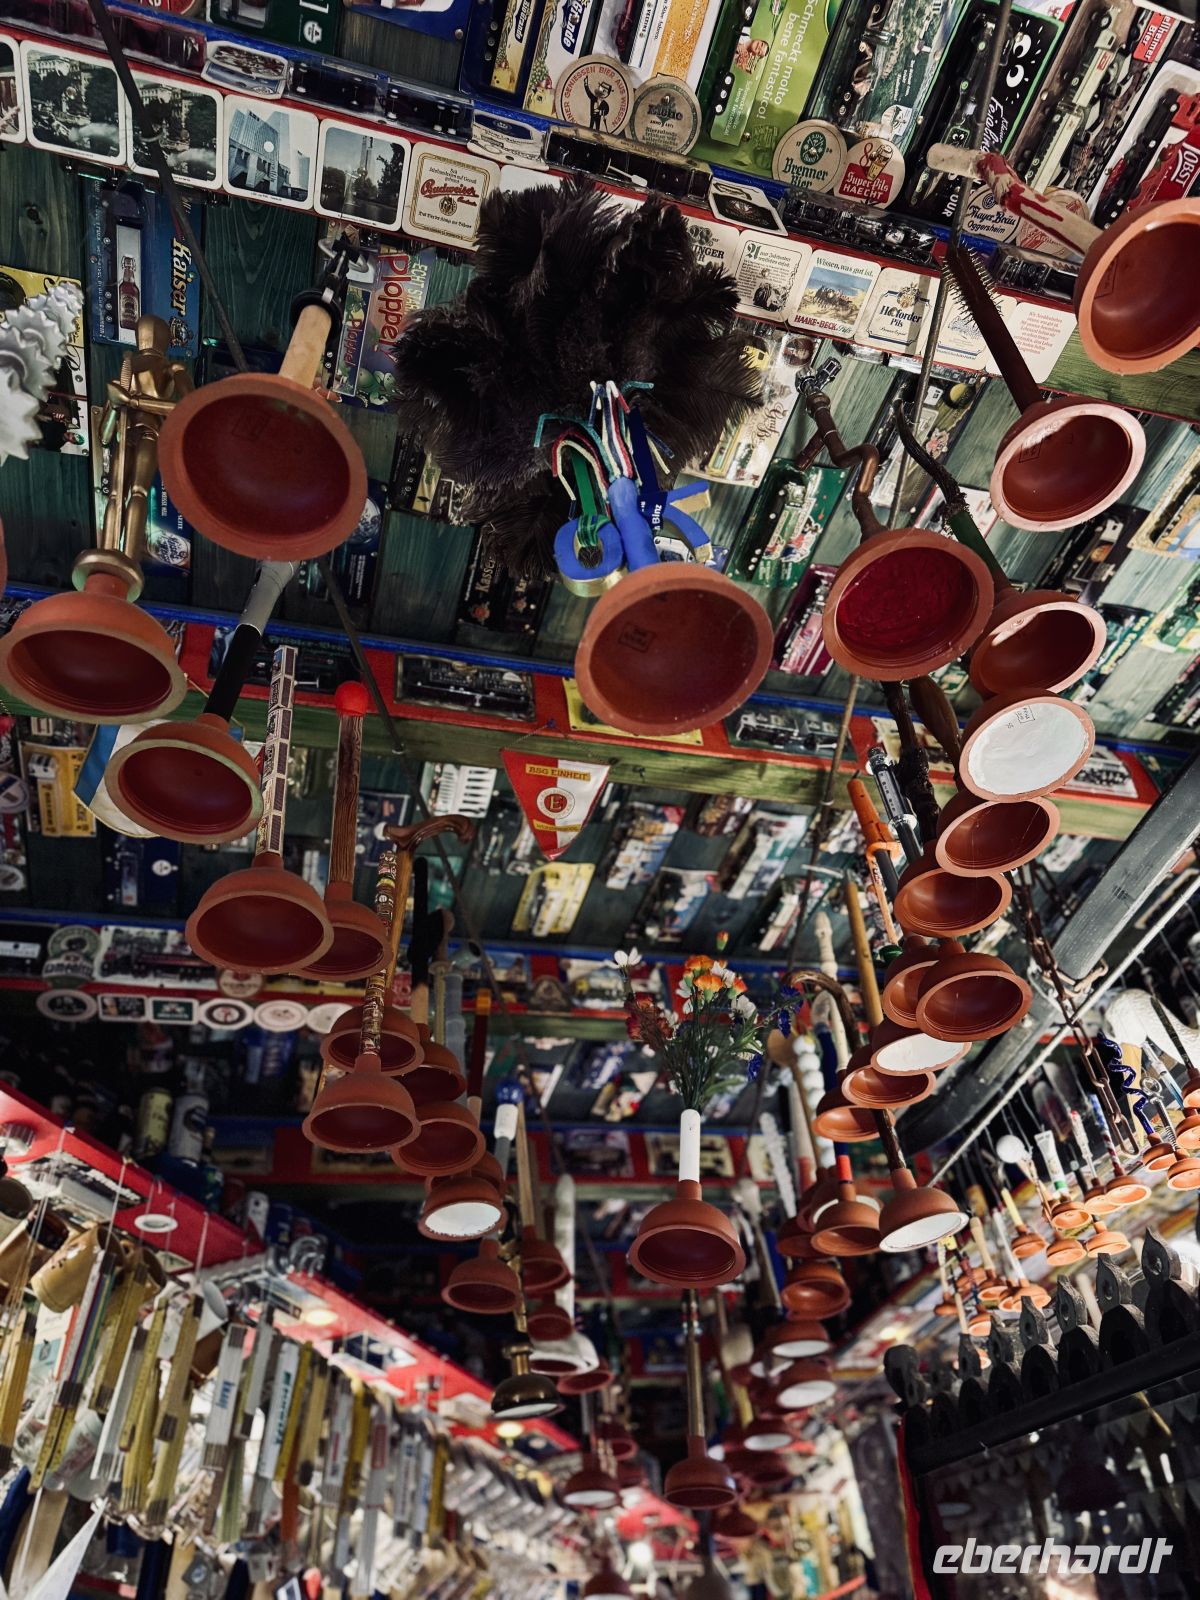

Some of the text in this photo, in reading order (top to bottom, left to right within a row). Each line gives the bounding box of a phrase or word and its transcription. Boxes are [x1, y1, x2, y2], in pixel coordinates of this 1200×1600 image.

[563, 0, 584, 48] Grnde
[1146, 16, 1171, 60] ellheimer
[774, 0, 819, 105] Schmeckt molto
[599, 66, 617, 80] BIER
[757, 12, 800, 119] bene fantastico!
[782, 157, 828, 181] Brenner
[421, 179, 480, 199] Budweiser
[843, 183, 884, 200] HAECHT
[816, 257, 840, 270] Wissen,
[171, 238, 192, 316] Kaiser
[405, 288, 421, 314] STAR
[794, 314, 837, 331] HAAKE-BECK
[890, 318, 904, 328] Pils
[651, 503, 662, 524] Binz
[528, 766, 588, 780] BSG EINHEIT
